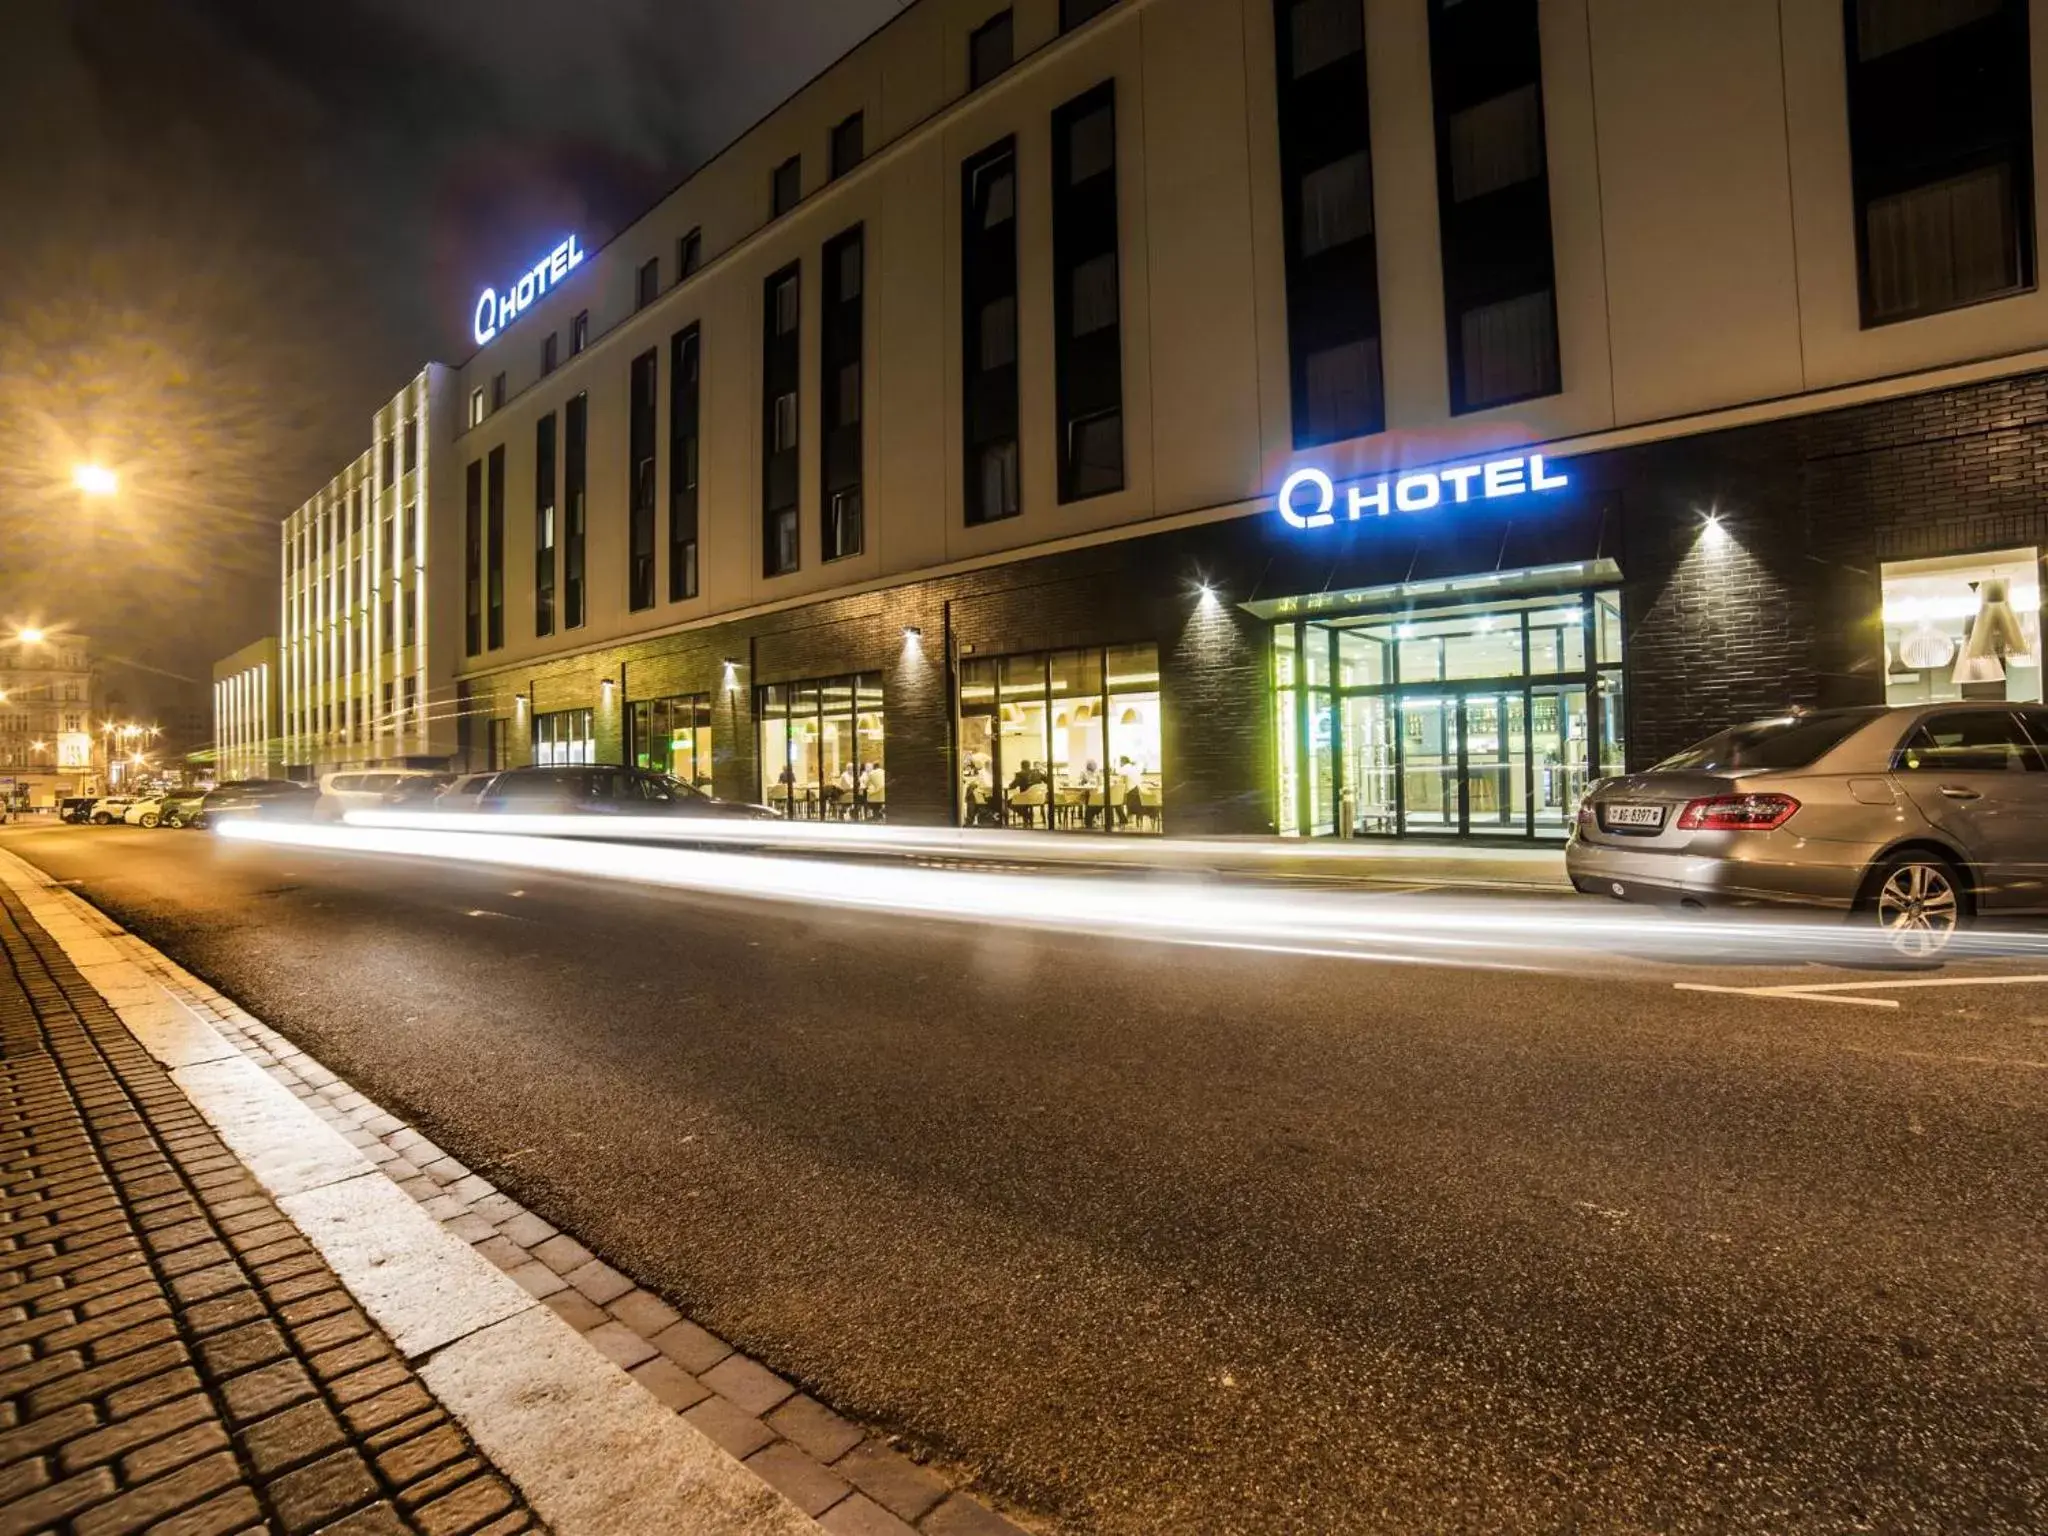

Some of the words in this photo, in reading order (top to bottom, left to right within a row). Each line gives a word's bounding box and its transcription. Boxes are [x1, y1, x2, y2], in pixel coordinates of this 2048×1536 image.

[474, 287, 496, 345] Q
[500, 234, 583, 328] HOTEL
[1278, 468, 1334, 529] Q
[1348, 454, 1568, 520] HOTEL
